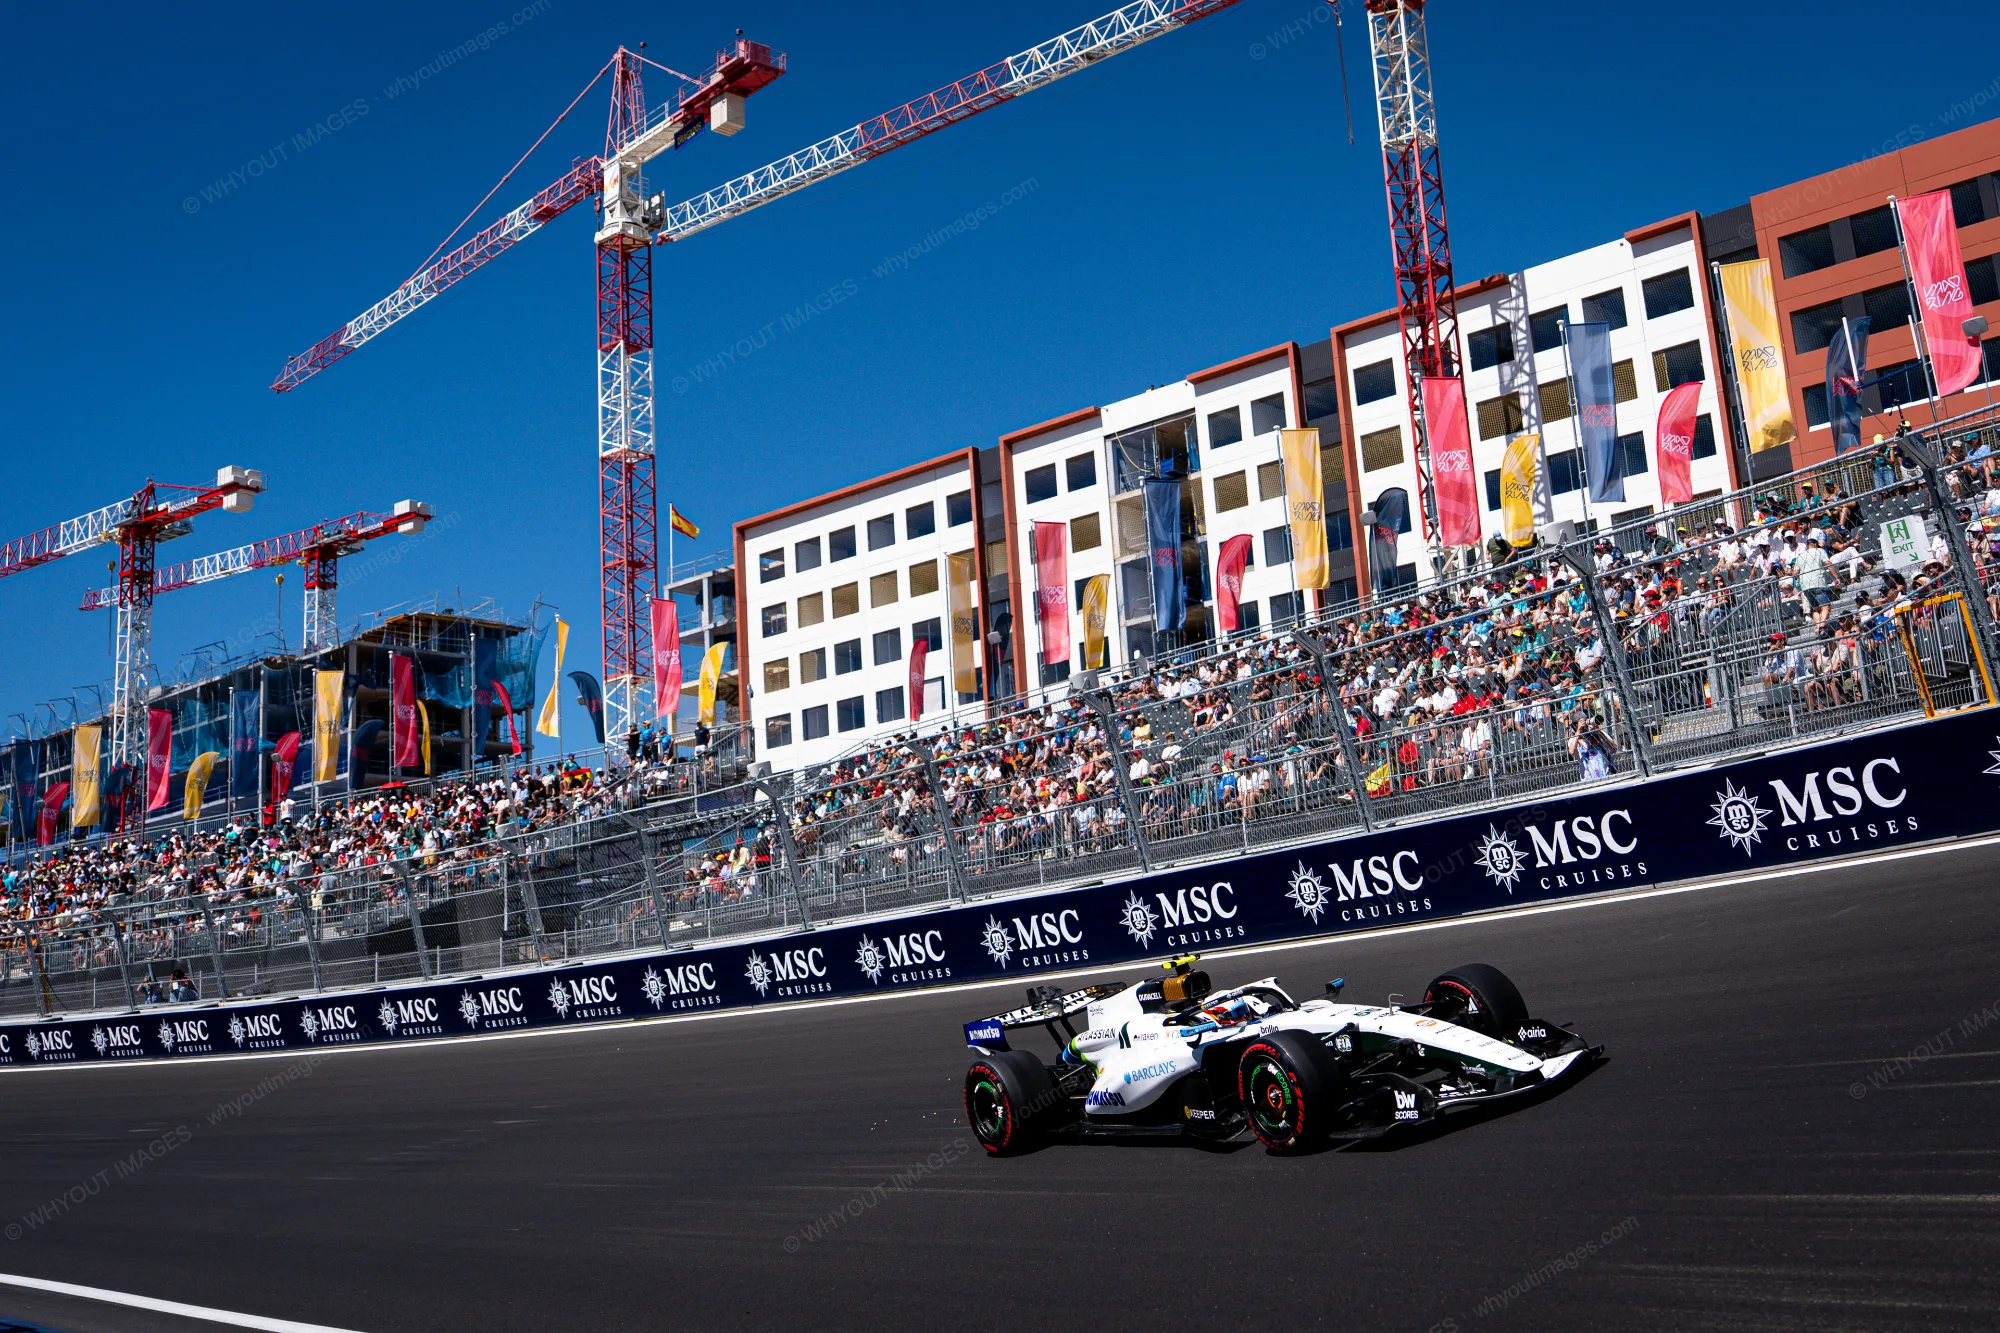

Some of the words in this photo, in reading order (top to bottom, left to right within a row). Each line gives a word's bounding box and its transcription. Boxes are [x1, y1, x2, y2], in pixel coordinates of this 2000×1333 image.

[1892, 542, 1914, 554] EXIT
[1769, 757, 1907, 826] MSC
[1525, 810, 1638, 868] MSC
[1787, 817, 1918, 850] CRUISES
[1328, 851, 1424, 902] MSC
[1541, 863, 1647, 888] CRUISES
[1156, 882, 1238, 929] MSC
[1342, 899, 1432, 921] CRUISES
[1012, 910, 1083, 951] MSC
[1168, 926, 1245, 946] CRUISES
[883, 930, 945, 967] MSC
[1023, 950, 1089, 967] CRUISES
[770, 948, 826, 981] MSC
[665, 963, 715, 995] MSC
[893, 968, 951, 983] CRUISES
[569, 976, 617, 1005] MSC
[779, 983, 831, 996] CRUISES
[1138, 992, 1162, 1002] DURACELL
[397, 998, 438, 1023] MSC
[479, 987, 523, 1015] MSC
[672, 996, 721, 1008] CRUISES
[318, 1006, 356, 1030] MSC
[486, 1017, 528, 1028] CRUISES
[576, 1007, 622, 1018] CRUISES
[107, 1025, 140, 1046] MSC
[174, 1020, 208, 1042] MSC
[245, 1014, 281, 1037] MSC
[403, 1026, 442, 1035] CRUISES
[968, 1026, 1000, 1040] KOMATSU
[1078, 1028, 1116, 1042] ATLASSIAN
[1526, 1026, 1546, 1038] airia
[40, 1030, 73, 1050] MSC
[324, 1033, 360, 1042] CRUISES
[1132, 1060, 1177, 1082] BARCLAYS
[1276, 1072, 1292, 1104] SCORES
[1394, 1090, 1416, 1109] bw
[1190, 1110, 1216, 1120] KEEPER
[1394, 1110, 1418, 1120] SCORES
